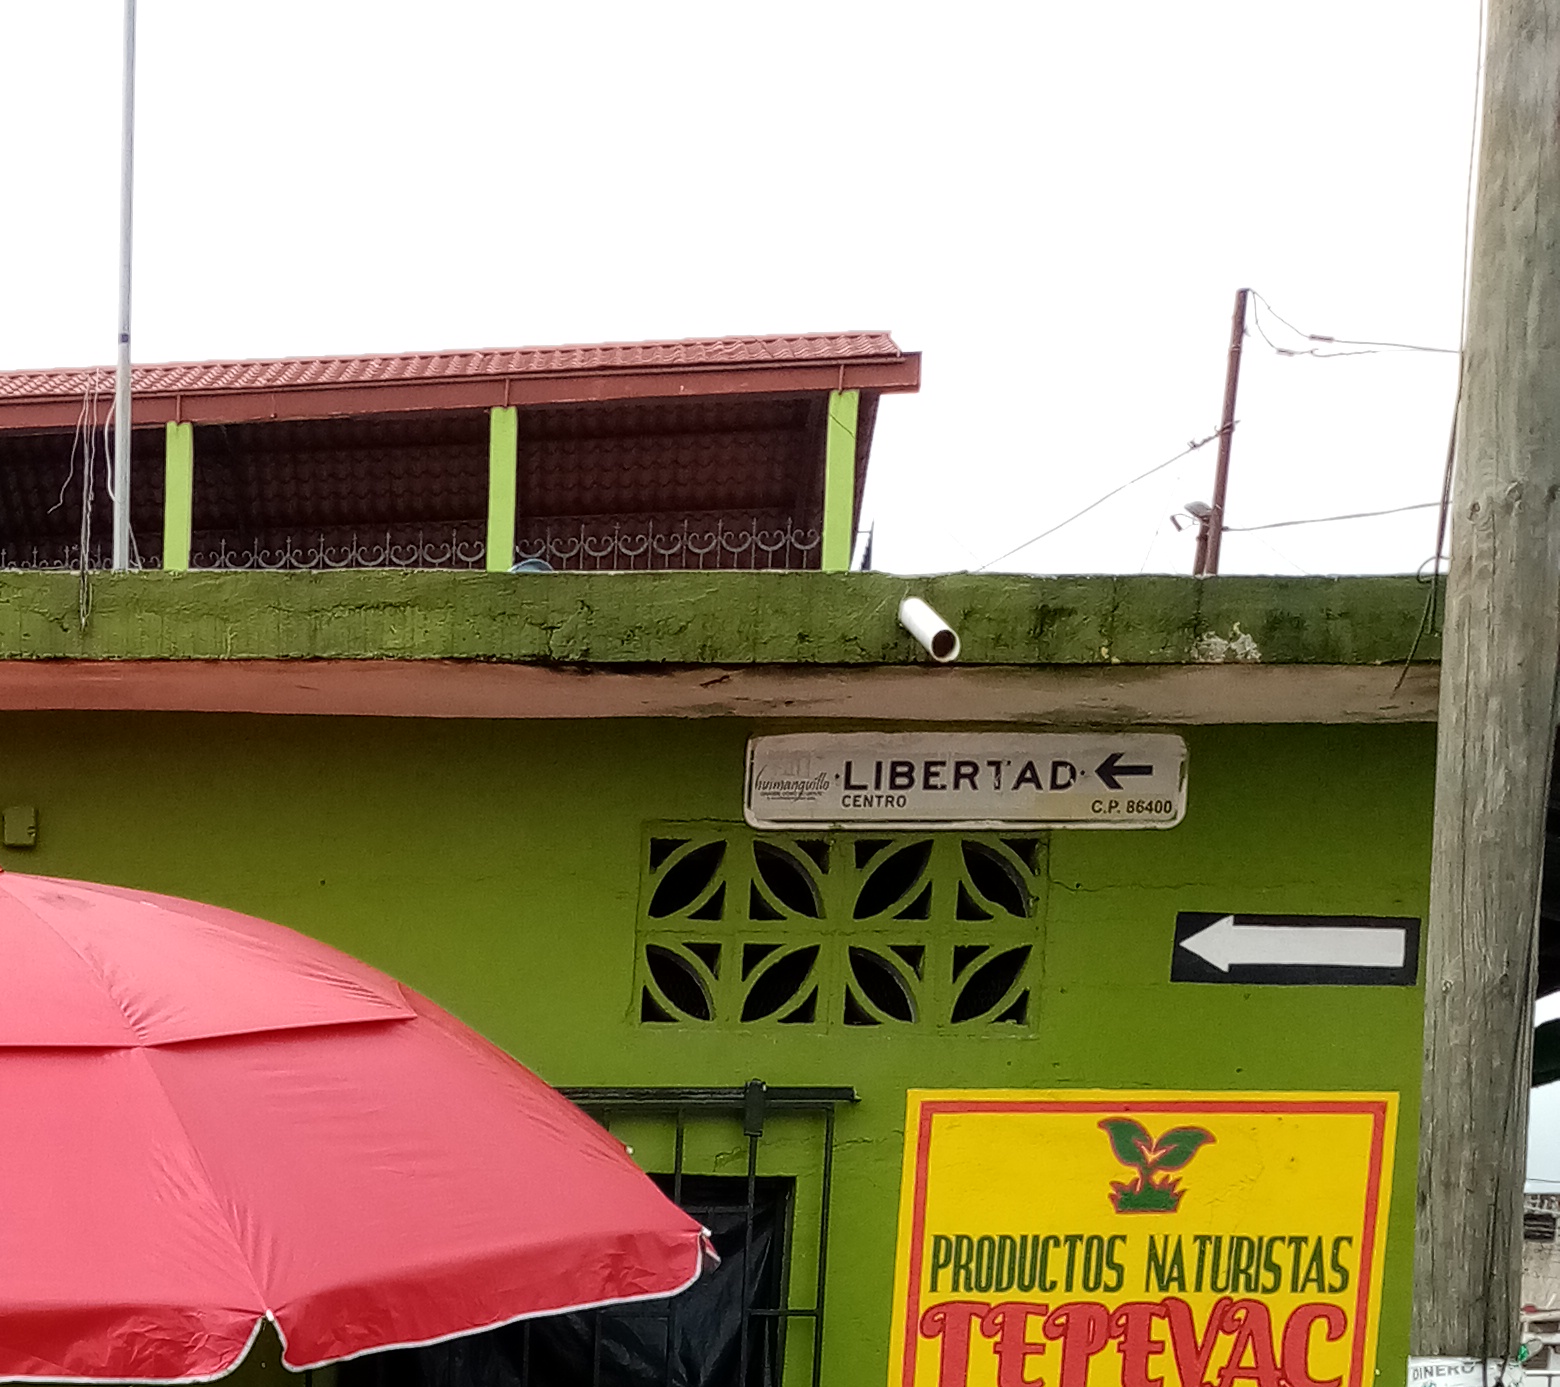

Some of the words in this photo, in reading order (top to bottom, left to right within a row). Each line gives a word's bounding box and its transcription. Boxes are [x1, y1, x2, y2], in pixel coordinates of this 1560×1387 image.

[843, 760, 1077, 791] LIBERTAD
[841, 795, 907, 808] CENTRO
[1091, 799, 1121, 814] C.P.
[1126, 799, 1172, 814] 86400
[928, 1234, 1128, 1294] PRODUCTOS
[1143, 1234, 1354, 1294] NATURISTAS
